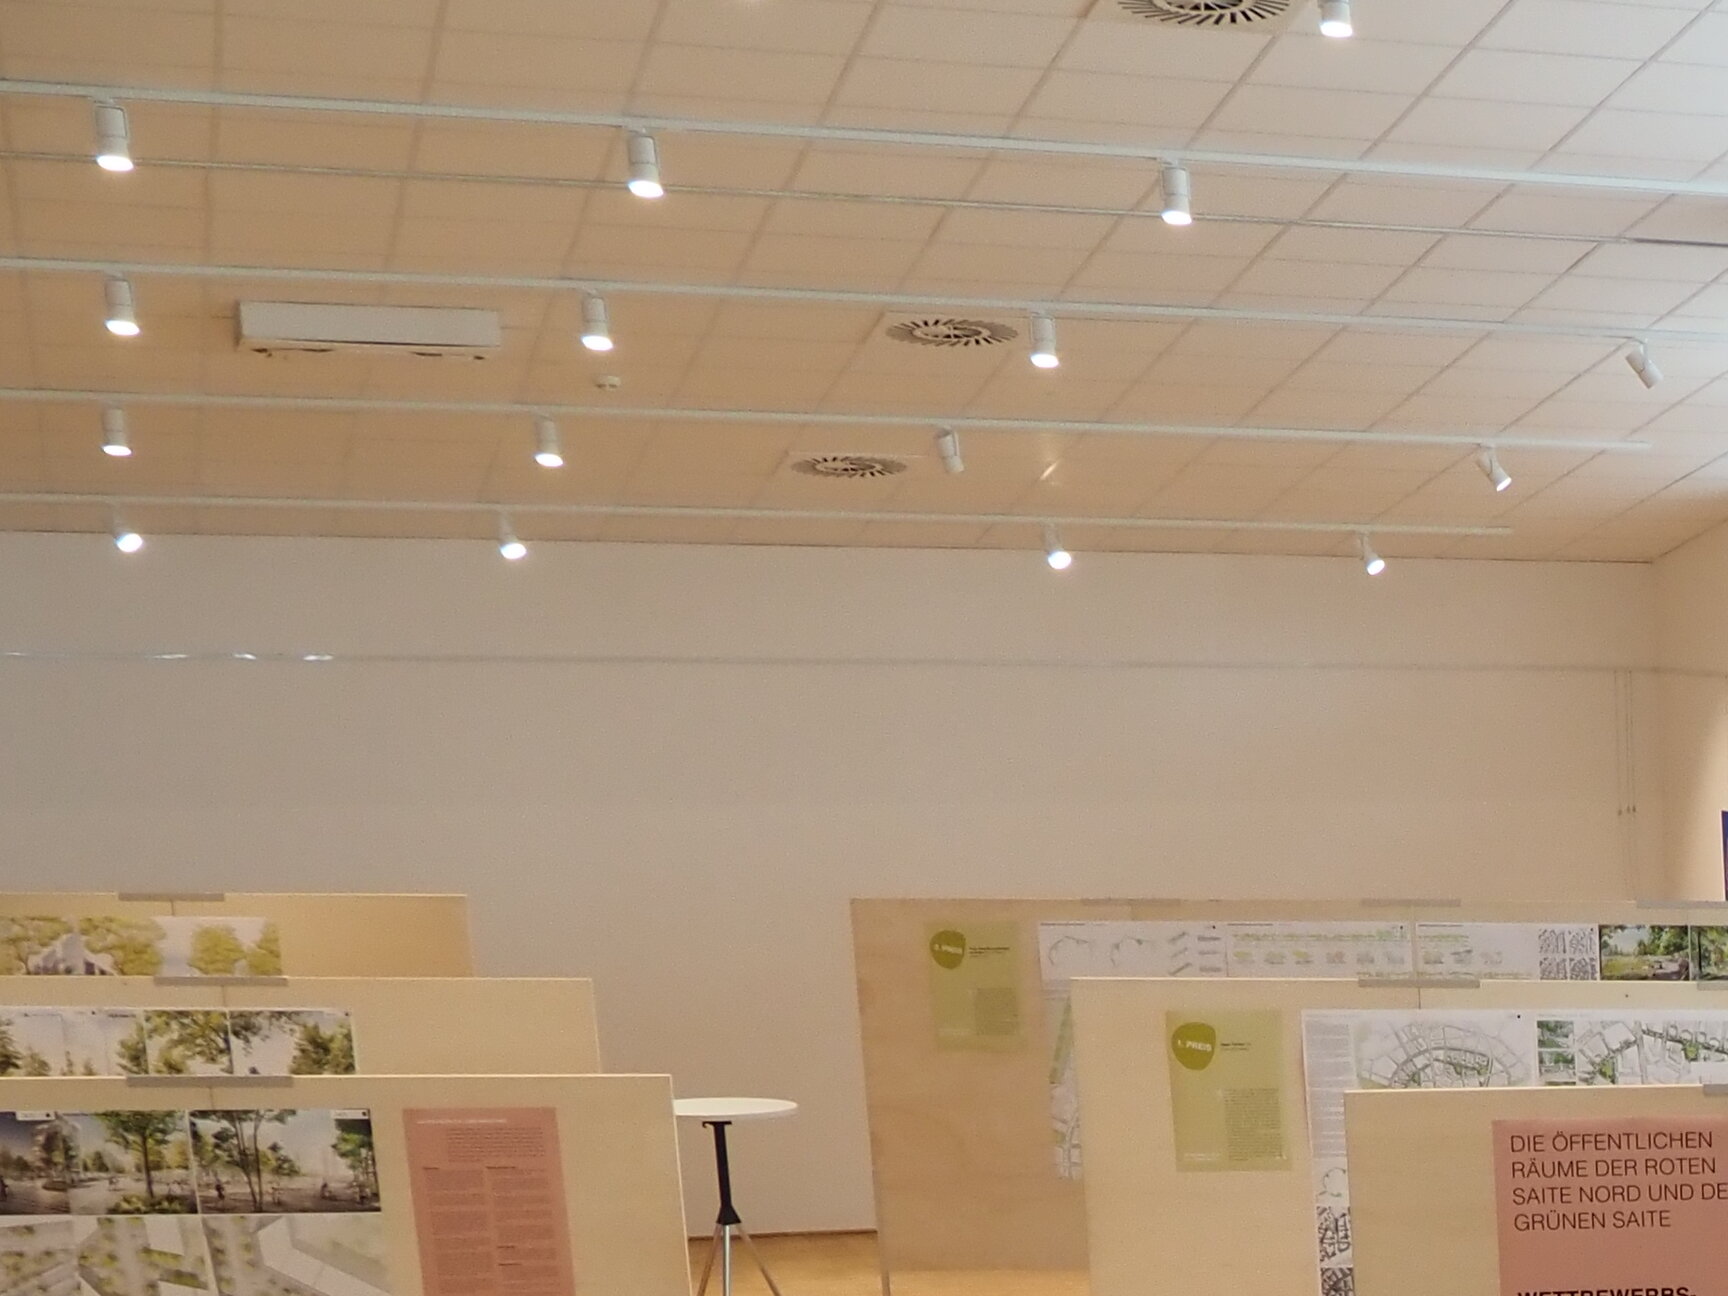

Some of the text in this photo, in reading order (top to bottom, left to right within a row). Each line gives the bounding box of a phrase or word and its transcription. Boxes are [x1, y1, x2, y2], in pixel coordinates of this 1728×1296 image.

[1510, 1131, 1713, 1152] DIE ÖFFENTLICHEN
[1512, 1157, 1717, 1178] RÄUME DER ROTEN
[1512, 1187, 1571, 1205] SAITE
[1580, 1185, 1641, 1203] NORD
[1649, 1184, 1694, 1201] UND
[1514, 1210, 1672, 1231] GRÜNEN SAITE
